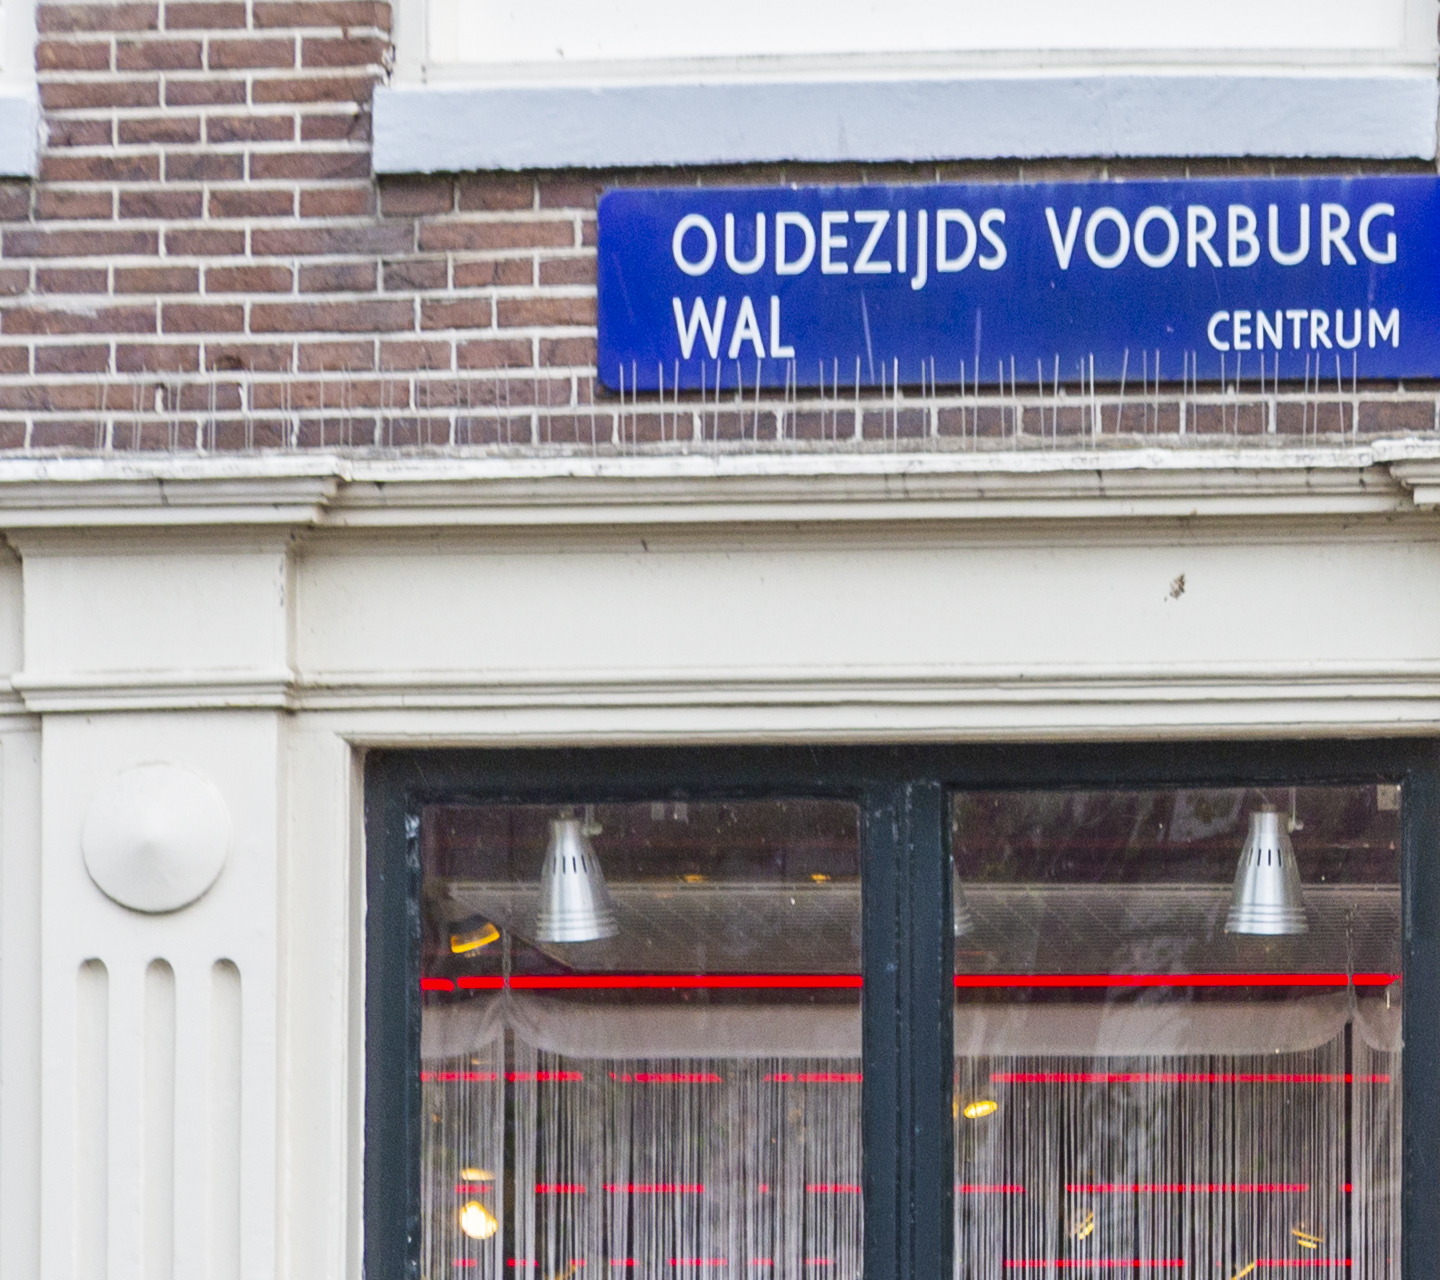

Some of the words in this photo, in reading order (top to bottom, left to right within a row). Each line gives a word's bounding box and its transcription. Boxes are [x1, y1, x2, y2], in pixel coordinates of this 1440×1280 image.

[672, 209, 1007, 290] OUDEZIJDS
[1046, 203, 1397, 270] VOORBURG
[672, 296, 795, 360] WAL
[1207, 308, 1400, 352] CENTRUM
